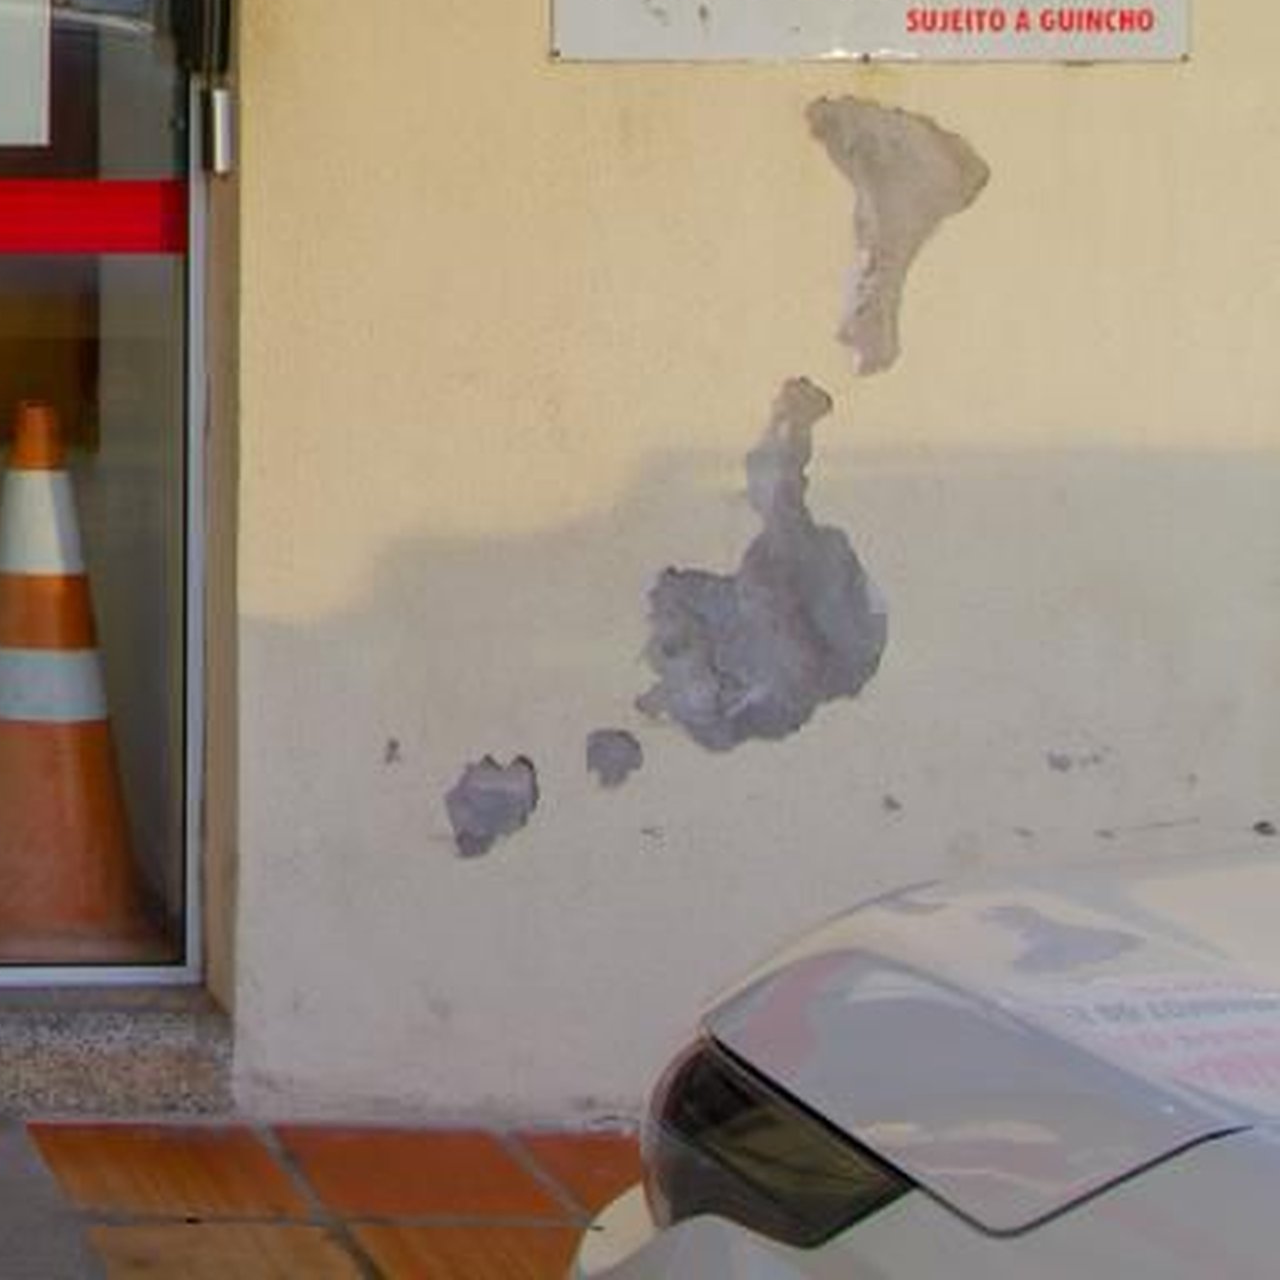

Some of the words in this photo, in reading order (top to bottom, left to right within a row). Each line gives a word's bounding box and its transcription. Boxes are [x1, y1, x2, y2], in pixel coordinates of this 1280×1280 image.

[906, 8, 1007, 33] SUJEITO
[1015, 9, 1032, 33] A
[1039, 8, 1156, 33] GUINCHO
